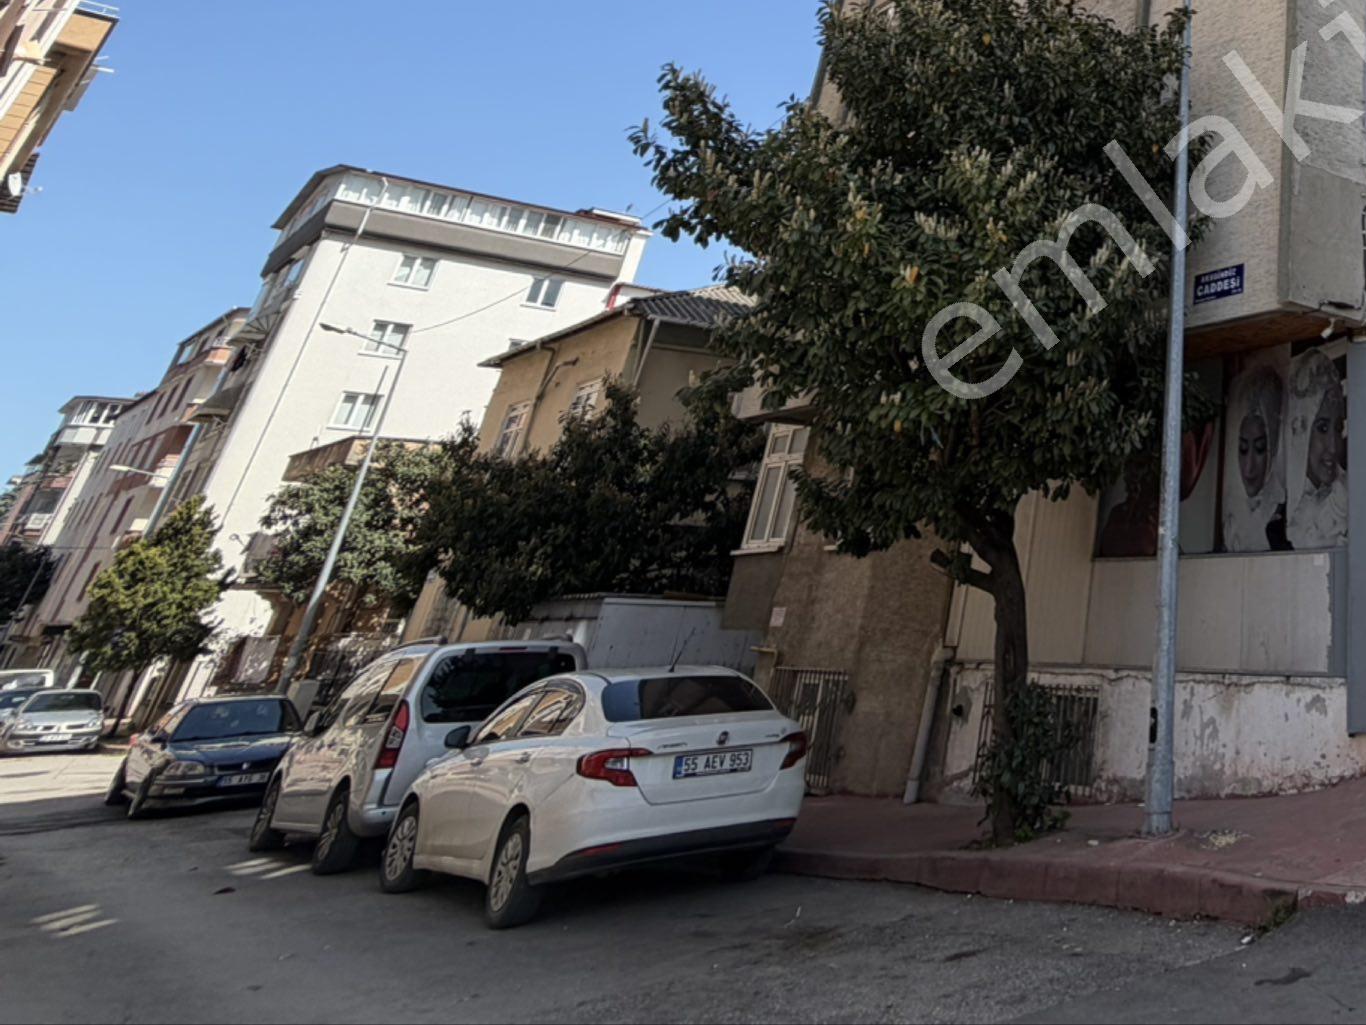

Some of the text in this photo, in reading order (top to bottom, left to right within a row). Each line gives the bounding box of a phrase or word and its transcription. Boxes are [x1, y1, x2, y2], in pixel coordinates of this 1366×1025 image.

[1196, 275, 1241, 297] CADDESİ
[684, 752, 749, 772] 55 AEV 953
